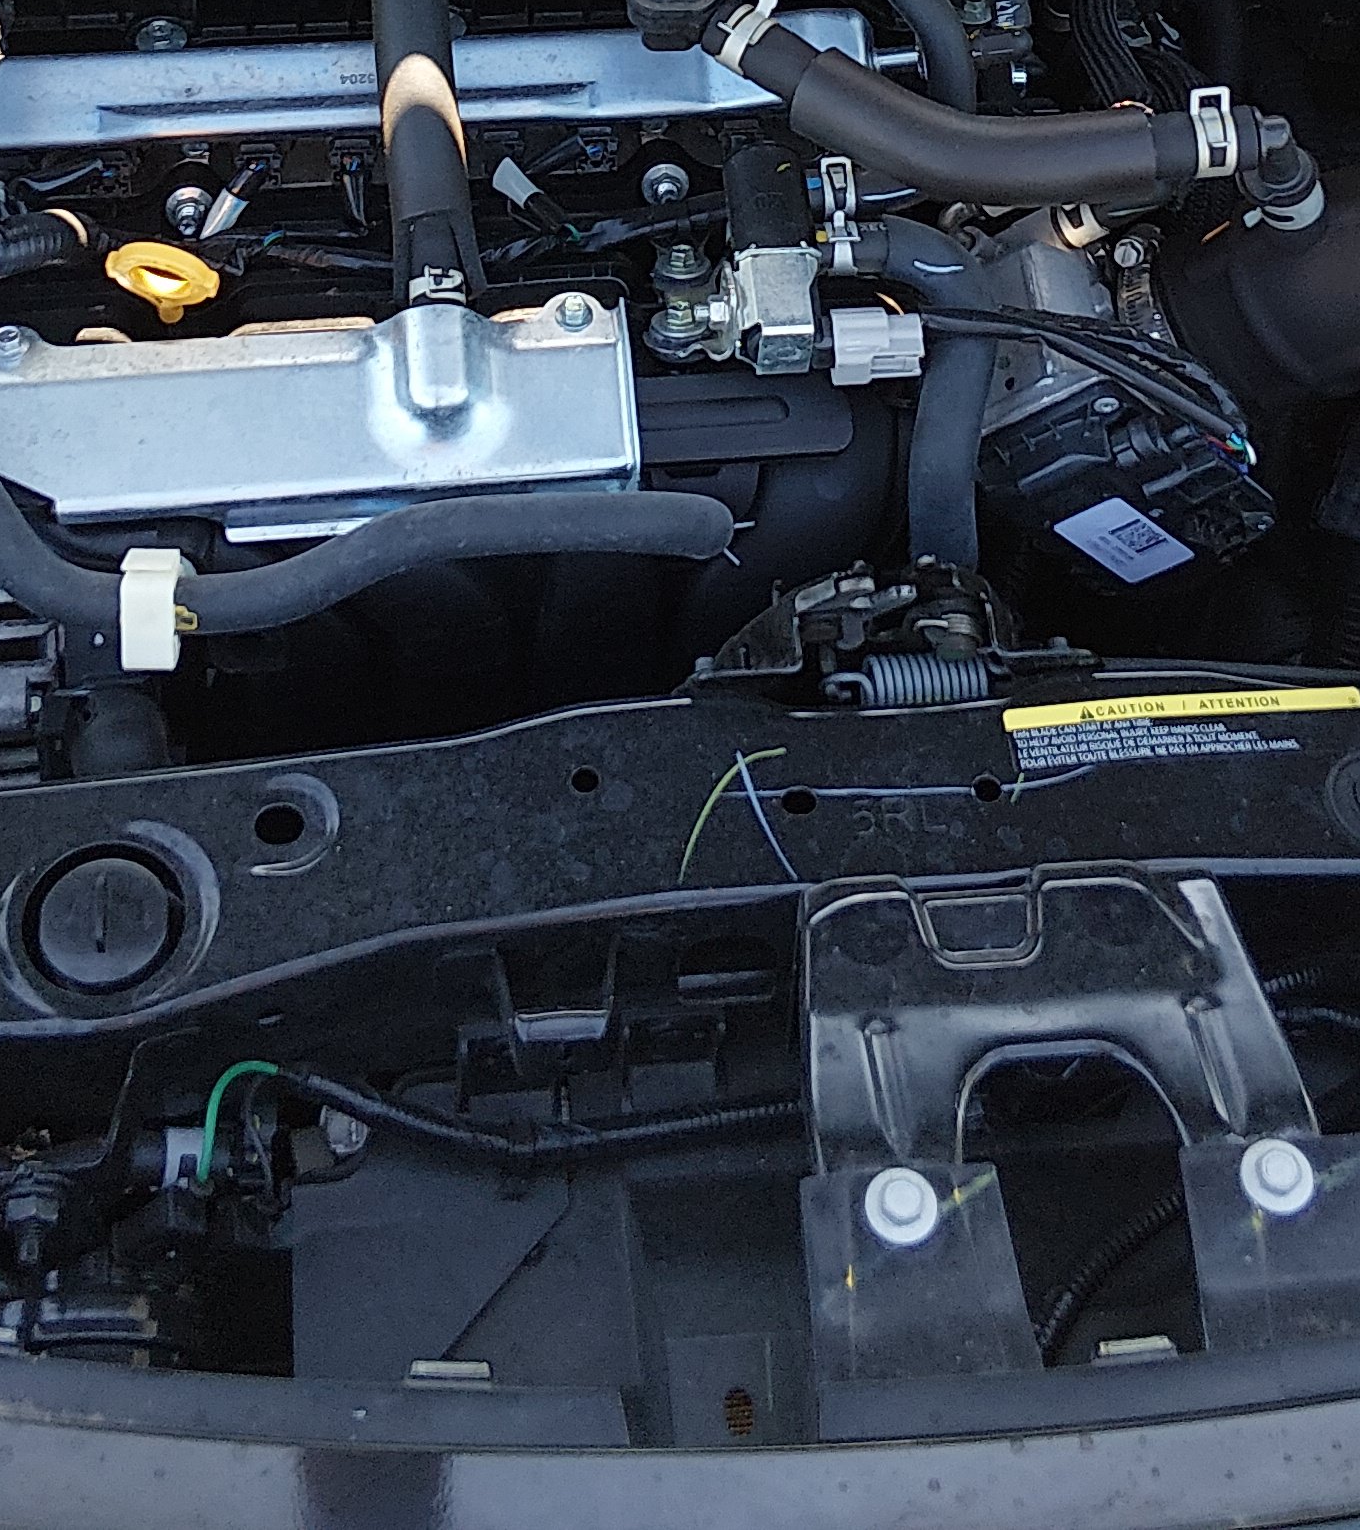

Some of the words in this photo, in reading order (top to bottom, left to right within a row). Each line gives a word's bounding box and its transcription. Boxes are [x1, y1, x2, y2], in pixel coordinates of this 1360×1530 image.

[1095, 701, 1166, 717] CAUTION
[1198, 695, 1281, 710] ATTENTION
[1015, 740, 1028, 748] TO
[1028, 737, 1050, 747] HELP
[1051, 734, 1077, 745] AVOID
[1077, 730, 1120, 742] PERSONAL
[1150, 725, 1169, 735] KEEP
[1170, 724, 1199, 734] HANDS
[1030, 725, 1057, 737] BLADE
[1058, 723, 1077, 734] CAN
[1077, 721, 1101, 732] START
[1102, 721, 1112, 729] AT
[1017, 748, 1029, 759] LE
[1029, 742, 1089, 757] VENTILATEUR
[1089, 738, 1122, 751] RISQUE
[1122, 737, 1136, 747] DE
[1194, 730, 1216, 742] TOUT
[1019, 758, 1048, 770] POUR
[1078, 750, 1108, 763] TOUTE
[1154, 745, 1168, 756] NE
[1169, 744, 1186, 754] PAS
[1186, 743, 1198, 753] EN
[1200, 740, 1252, 752] APPROCHER
[1252, 739, 1269, 750] LES
